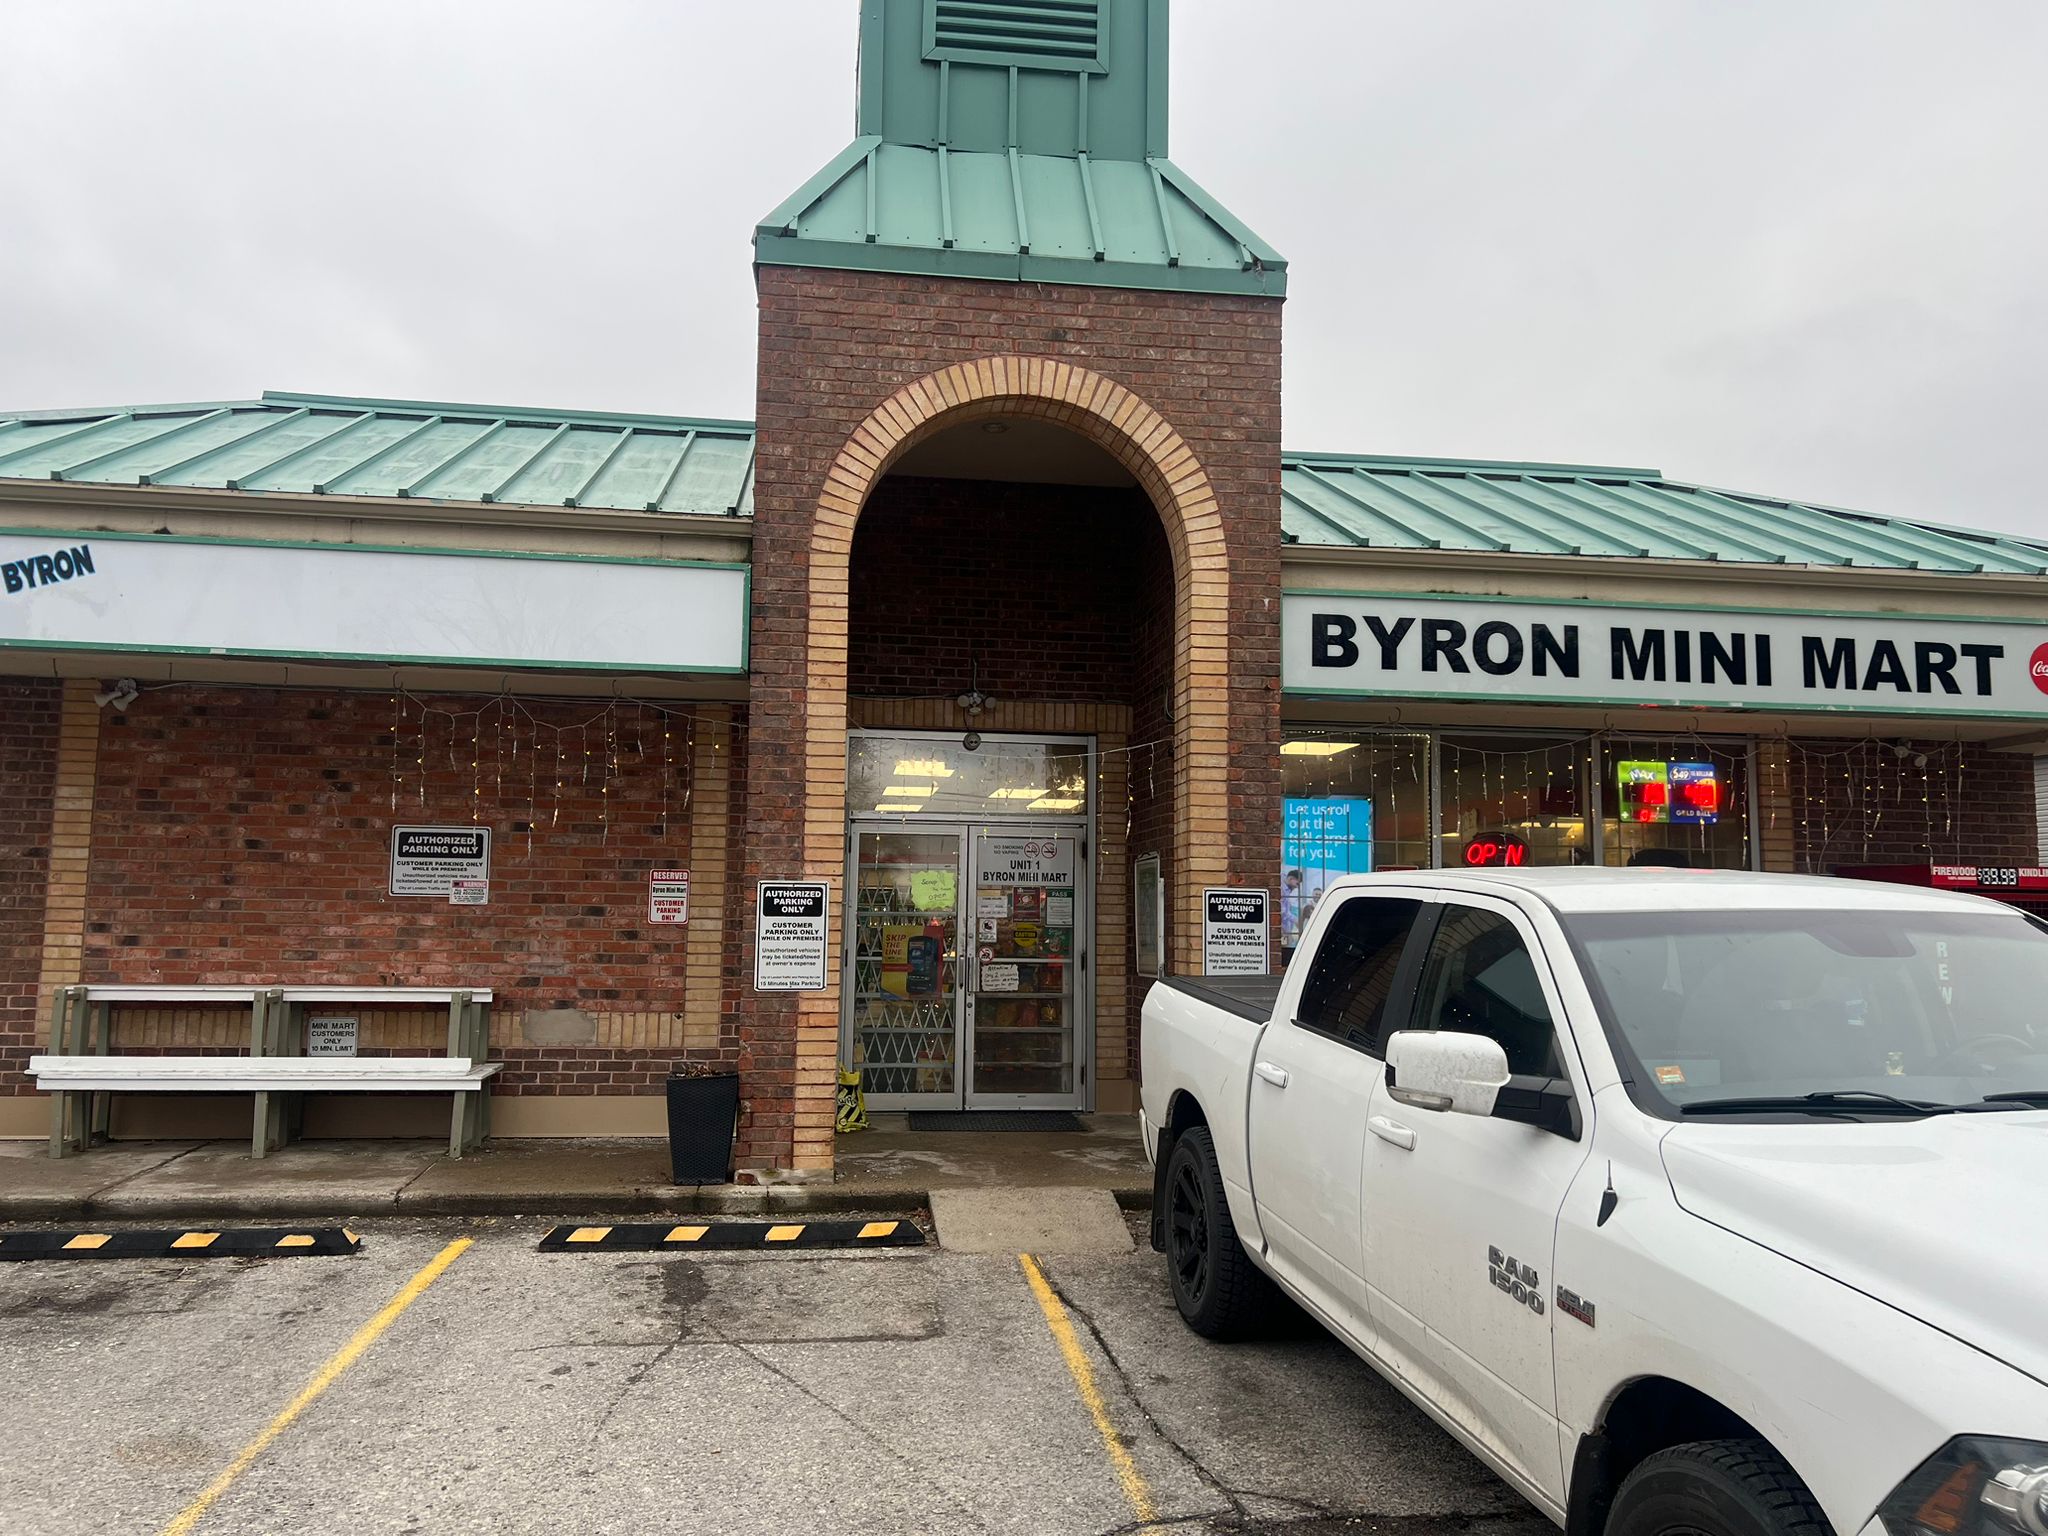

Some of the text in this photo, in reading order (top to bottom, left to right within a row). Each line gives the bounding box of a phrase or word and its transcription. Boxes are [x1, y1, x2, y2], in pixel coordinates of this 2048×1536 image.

[1, 544, 96, 594] BYRON
[1310, 612, 2004, 697] BYRON MINI MART
[1628, 768, 1656, 781] MAX
[1289, 803, 1350, 815] Let us roll
[1289, 818, 1335, 829] out the
[408, 836, 475, 845] AUTHORIZED
[402, 846, 479, 854] PARKING ONLY
[1010, 860, 1040, 870] UNIT 1
[1932, 866, 1976, 876] FIREWOOD
[653, 872, 688, 880] RESERVED
[982, 872, 1015, 881] BYRON
[1041, 872, 1068, 882] MART
[765, 890, 822, 898] AUTHORIZED
[773, 898, 813, 906] PARKING
[1210, 897, 1263, 905] AUTHORIZED
[1217, 904, 1255, 912] PARKING
[1225, 912, 1248, 920] ONLY
[884, 934, 906, 942] SKIP
[884, 948, 902, 956] LINE
[312, 1022, 356, 1030] MINI MART
[1488, 1244, 1540, 1290] RAM
[1488, 1264, 1545, 1316] 1500
